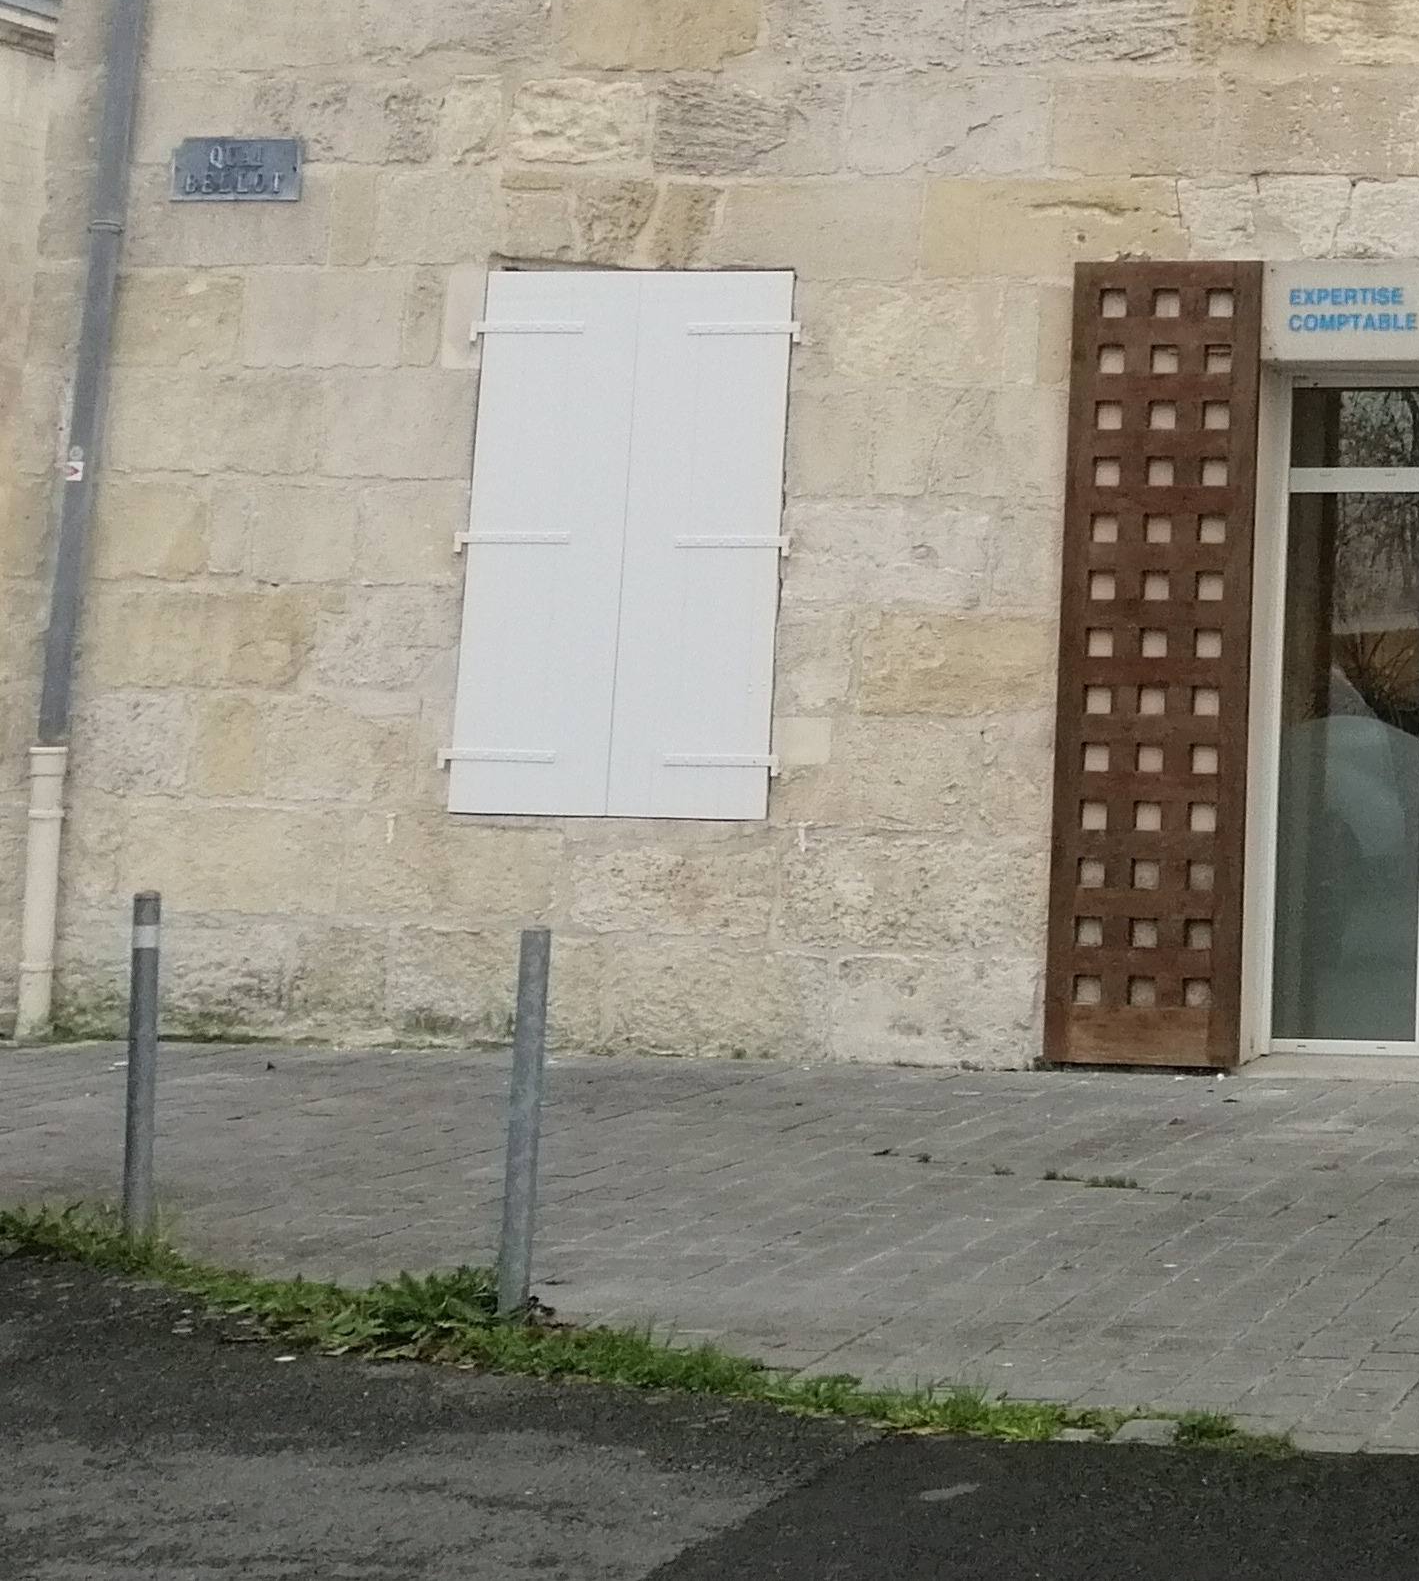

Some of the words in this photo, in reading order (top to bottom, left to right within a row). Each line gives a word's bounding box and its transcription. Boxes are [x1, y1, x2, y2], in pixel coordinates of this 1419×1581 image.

[209, 145, 264, 169] QUAI
[184, 171, 283, 194] BELLOT
[1289, 286, 1404, 305] EXPERTISE
[1288, 312, 1418, 331] COMPTABLE
